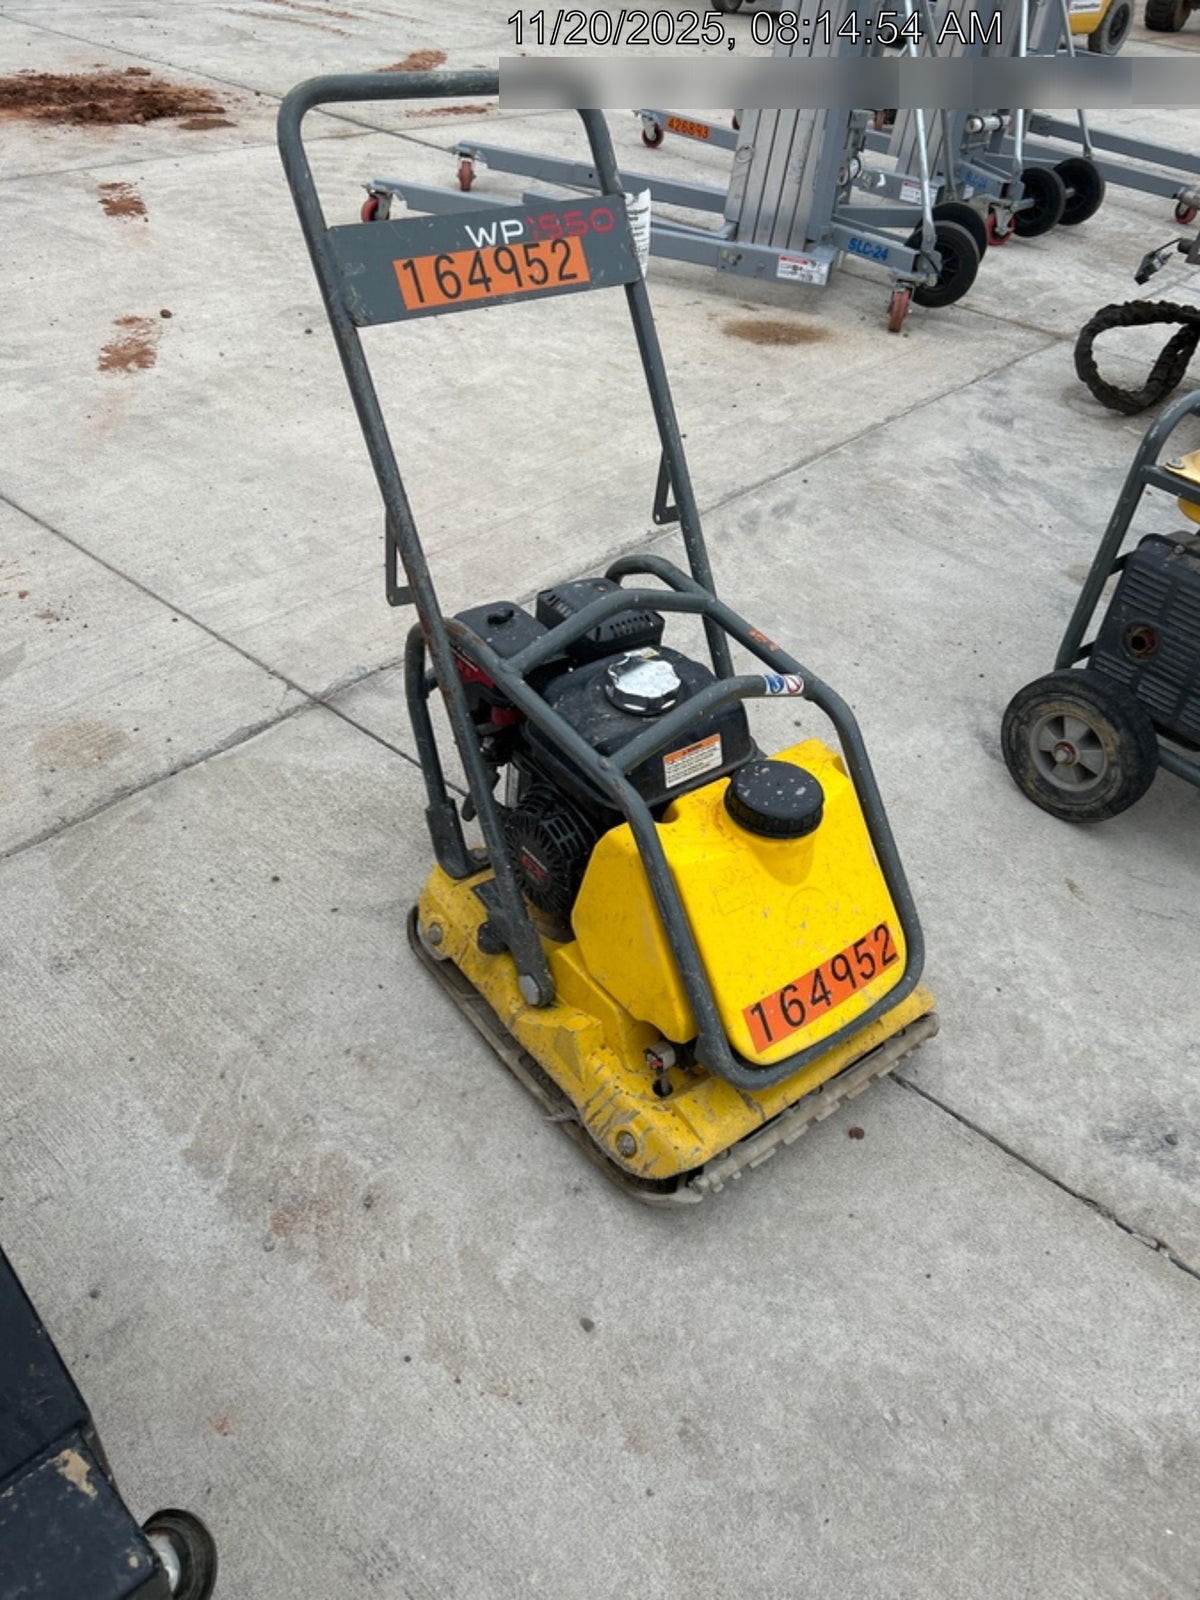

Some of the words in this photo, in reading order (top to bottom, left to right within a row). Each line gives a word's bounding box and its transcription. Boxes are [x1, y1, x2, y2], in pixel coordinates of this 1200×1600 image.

[403, 239, 577, 303] 164952
[848, 238, 889, 261] SLC-24
[751, 924, 897, 1042] 164952
